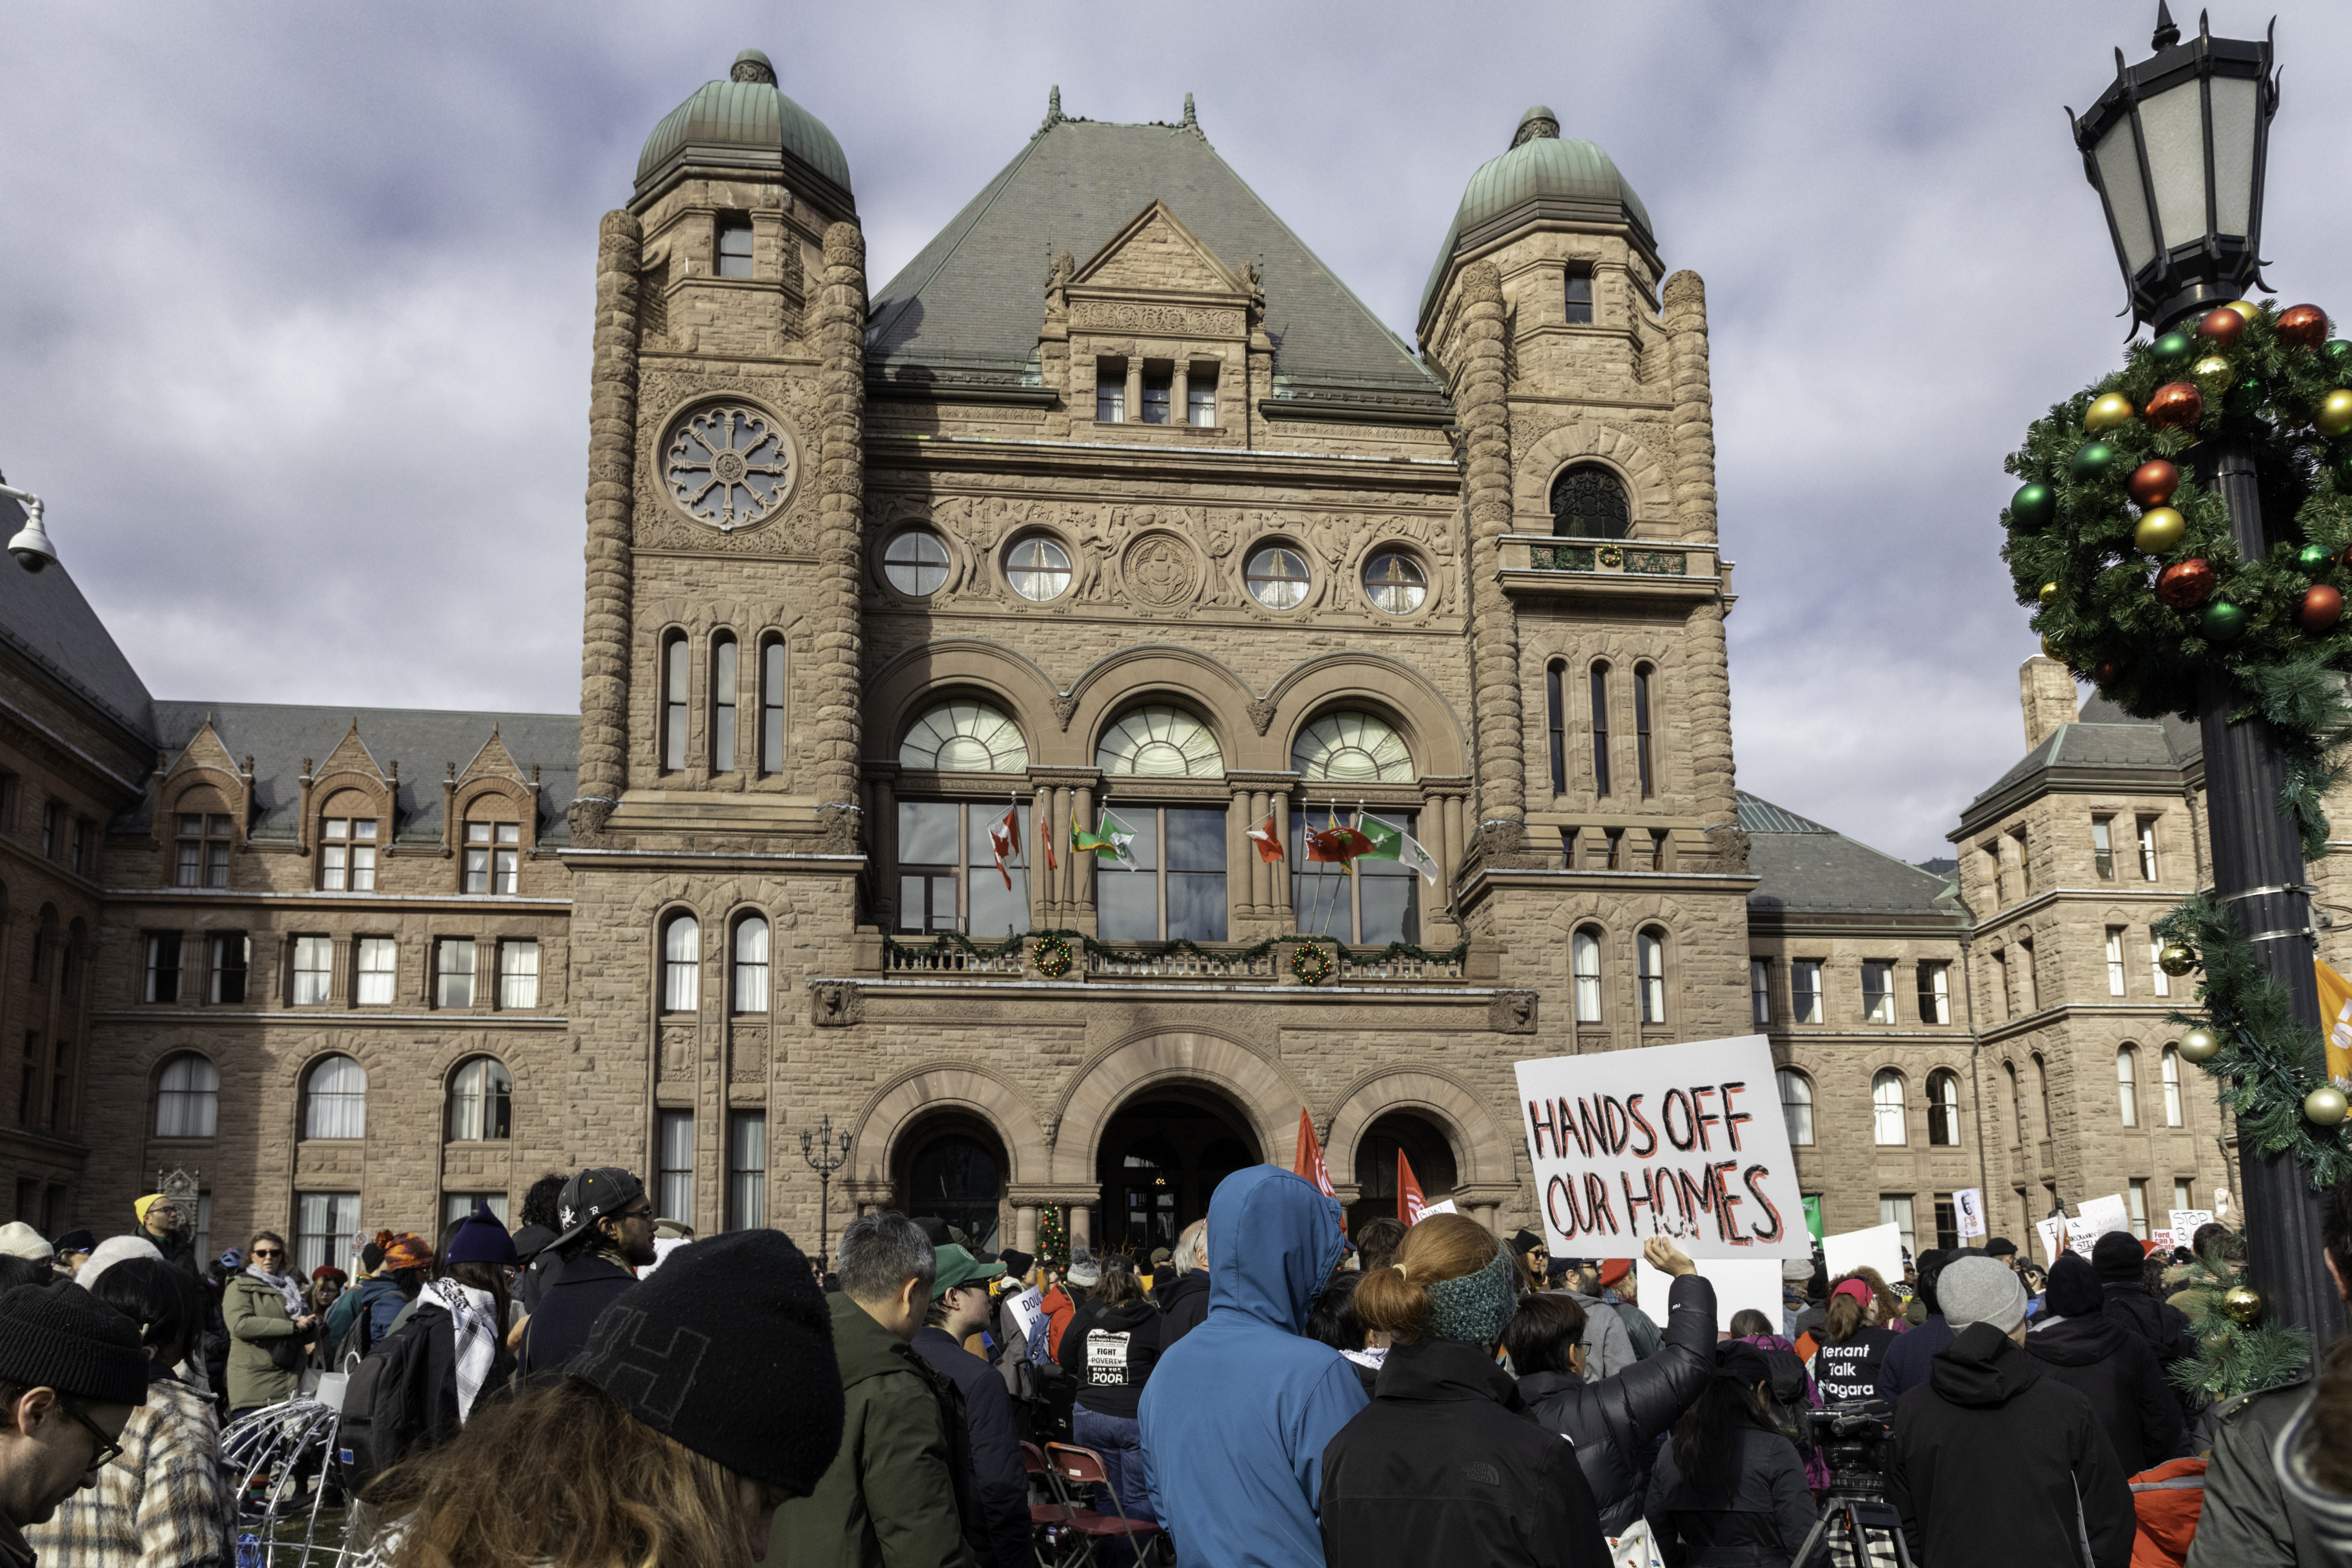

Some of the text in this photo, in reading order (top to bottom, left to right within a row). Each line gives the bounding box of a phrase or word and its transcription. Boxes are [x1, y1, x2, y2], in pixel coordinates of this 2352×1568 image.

[1529, 1081, 1753, 1160] HANDS OFF
[1547, 1159, 1784, 1247] OUR HOMES
[2173, 1212, 2208, 1225] STOP
[2176, 1227, 2194, 1241] BIL
[1022, 1293, 1042, 1312] DOUG
[1822, 1344, 1870, 1358] Tenant
[1828, 1362, 1856, 1376] Talk
[1092, 1373, 1123, 1383] POOR
[1461, 1466, 1486, 1476] NORTH
[1466, 1473, 1485, 1482] FACE
